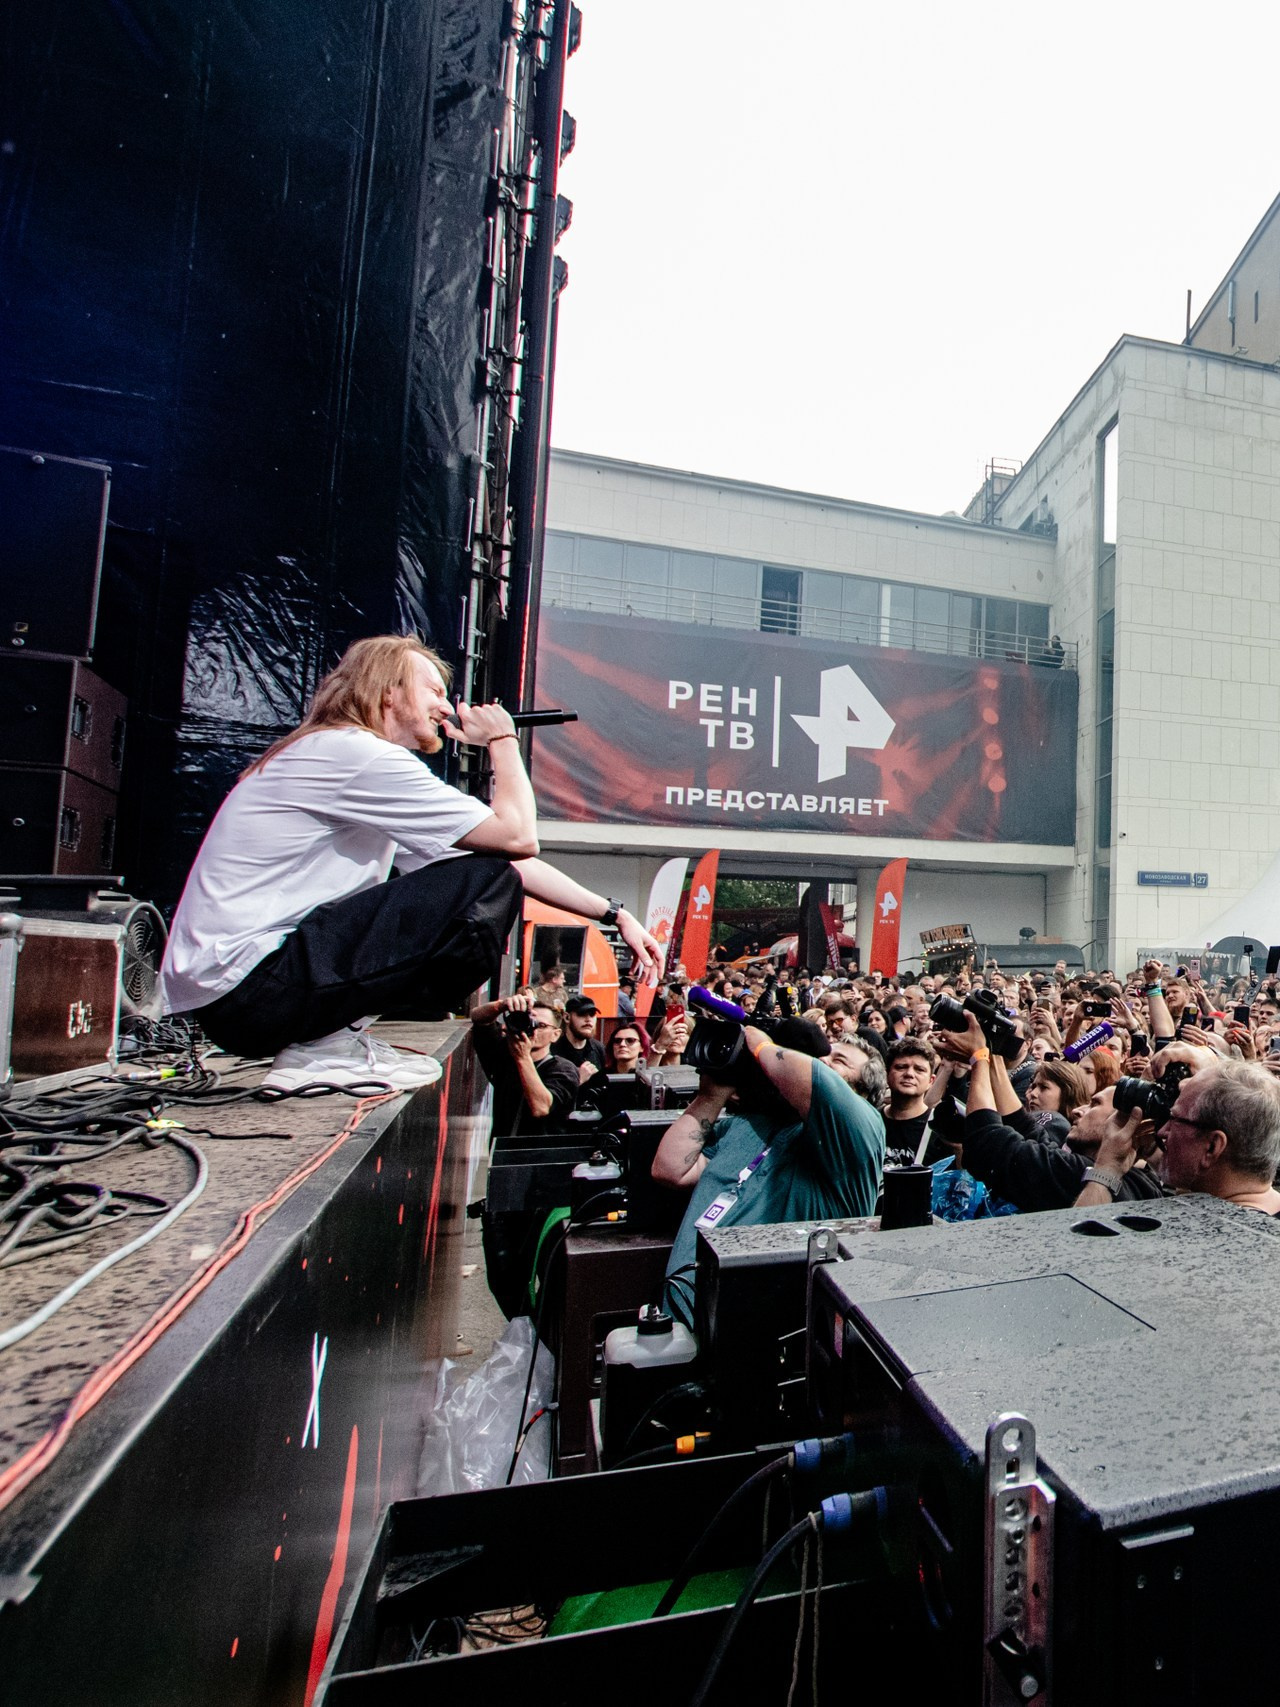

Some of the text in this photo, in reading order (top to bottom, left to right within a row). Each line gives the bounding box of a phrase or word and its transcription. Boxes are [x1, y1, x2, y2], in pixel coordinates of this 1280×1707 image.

[667, 680, 758, 717] РЕН
[699, 718, 756, 751] ТВ
[665, 785, 890, 817] ПРЕДСТАВЛЯЕТ
[1197, 875, 1207, 884] 27
[1078, 1033, 1109, 1059] ИЗВЕСТИЯ
